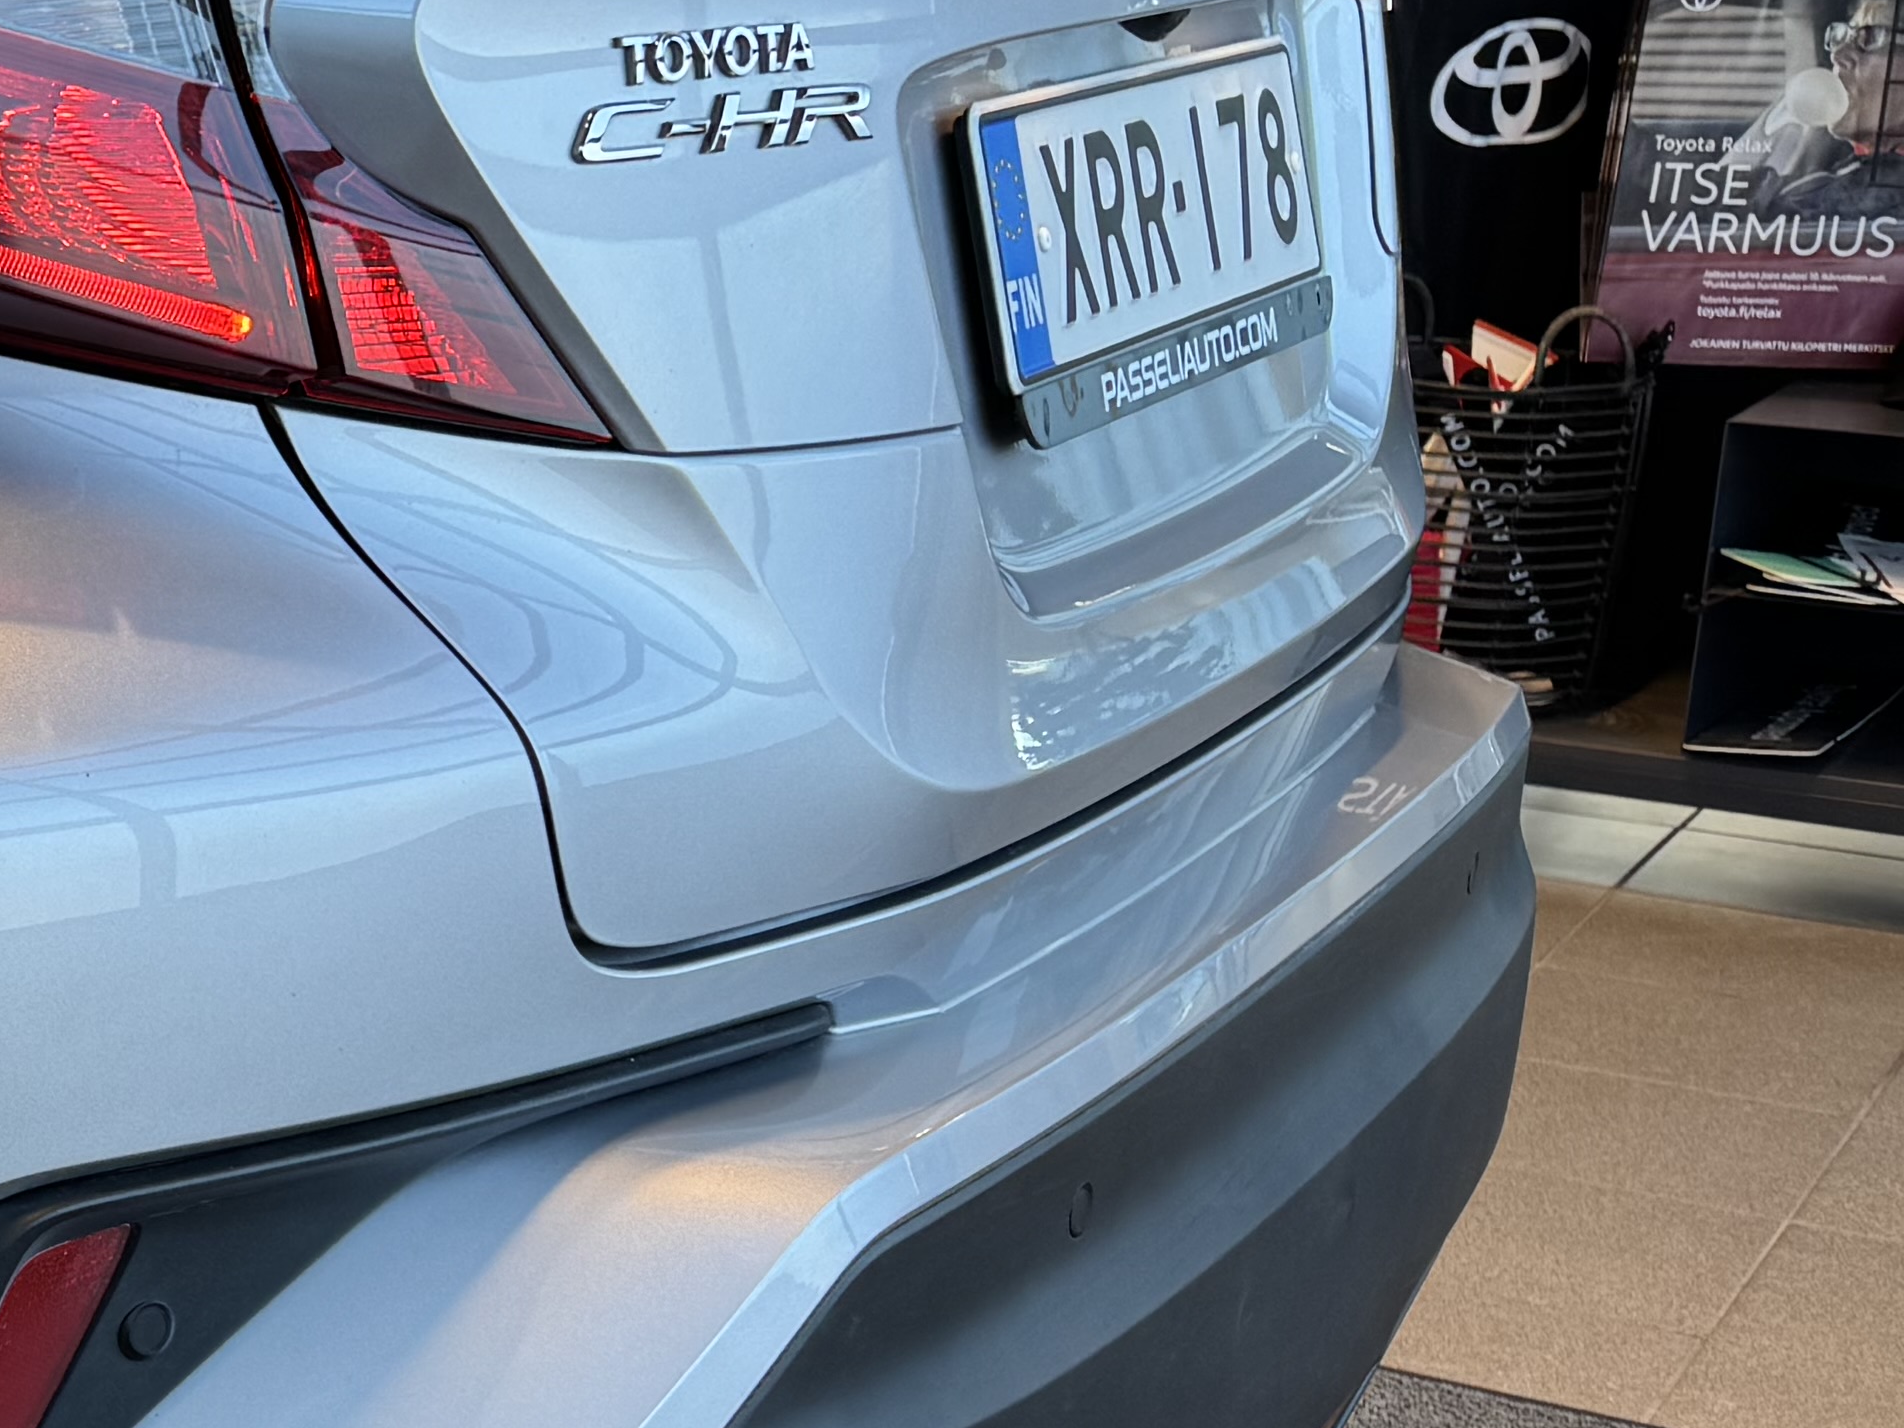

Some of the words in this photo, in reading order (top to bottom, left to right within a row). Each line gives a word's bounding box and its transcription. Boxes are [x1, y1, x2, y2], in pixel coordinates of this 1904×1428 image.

[612, 21, 815, 86] TOYOTA
[571, 82, 874, 166] C-HR
[1655, 134, 1716, 156] Toyota
[1722, 135, 1772, 153] Relax
[1039, 86, 1300, 326] XRR-178
[1648, 161, 1752, 206] ITSE
[1642, 209, 1898, 258] VARMUUS
[1005, 273, 1044, 334] FIN
[1697, 305, 1782, 320] toyota.fi/relax
[1100, 306, 1279, 413] PASSELIAUTO.COM
